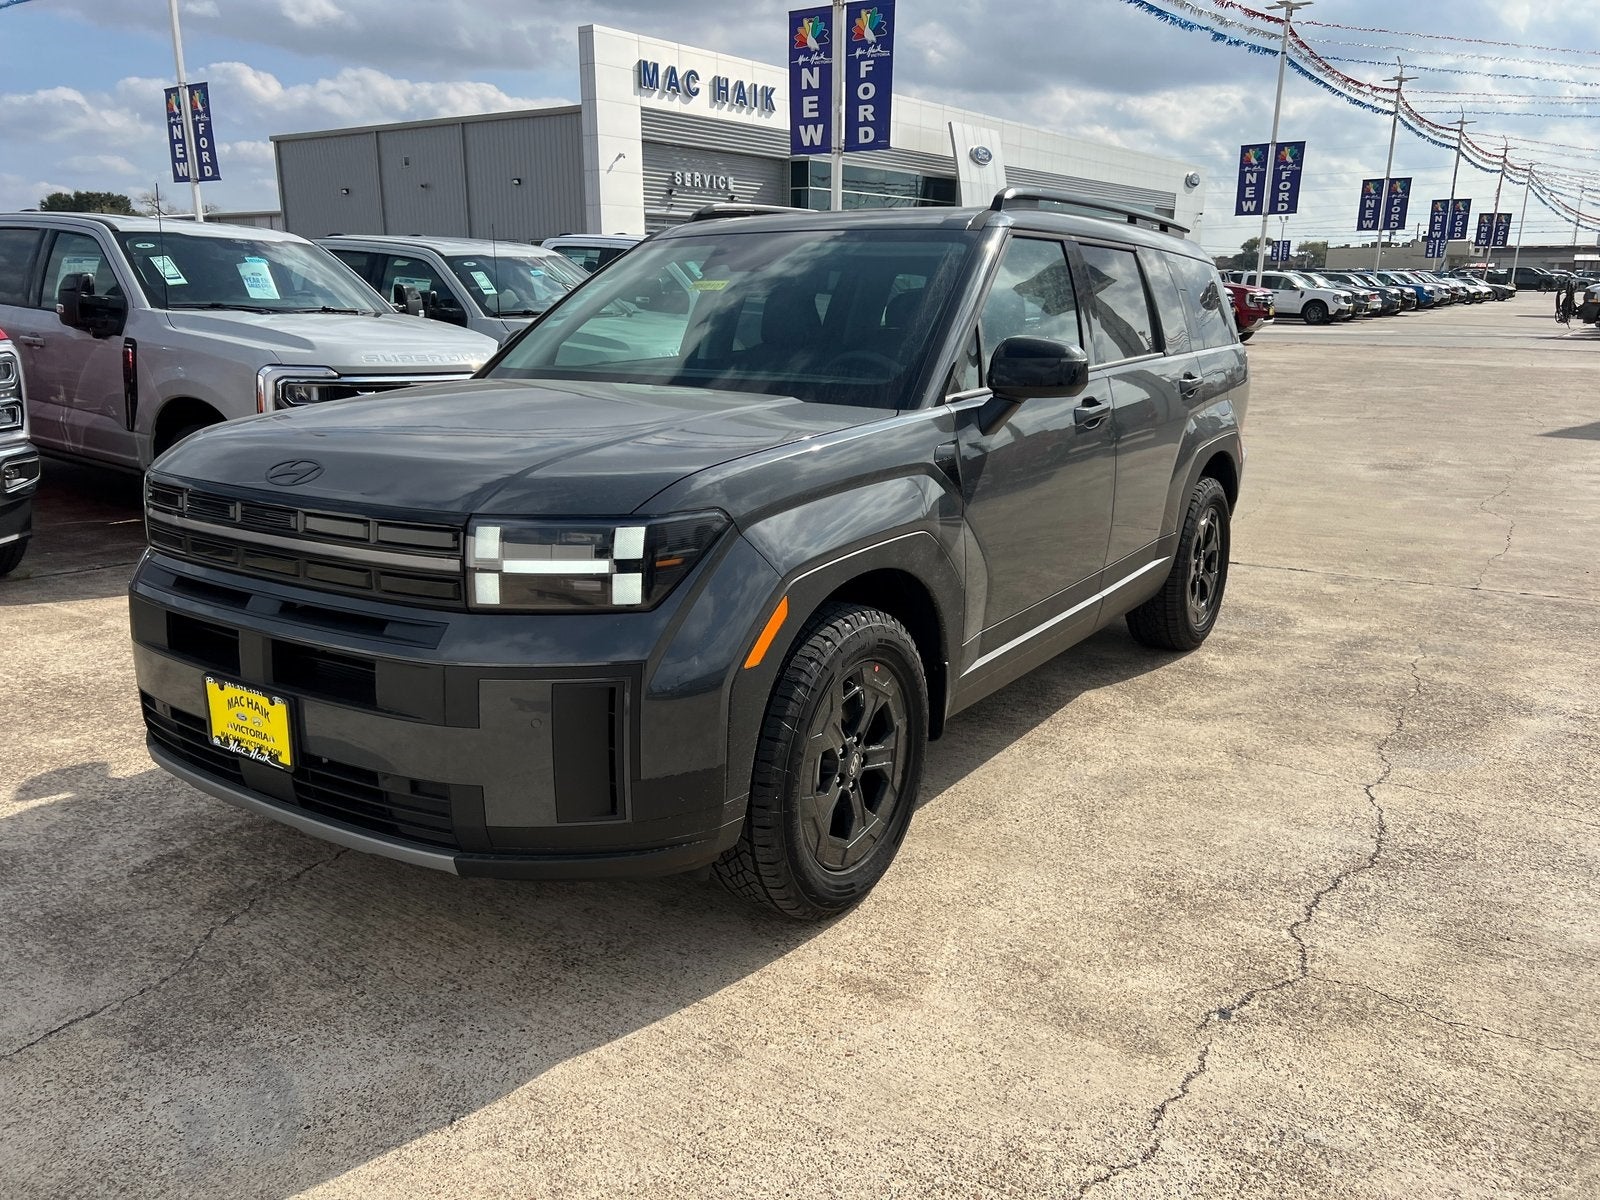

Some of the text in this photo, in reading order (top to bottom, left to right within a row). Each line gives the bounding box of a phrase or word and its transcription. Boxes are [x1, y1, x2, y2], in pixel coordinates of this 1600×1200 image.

[640, 59, 776, 112] MAC HAIK
[799, 67, 824, 146] NEW
[857, 60, 876, 144] FORD
[173, 124, 188, 177] NEW
[198, 123, 213, 177] FORD
[674, 170, 735, 191] SERVICE
[1241, 172, 1258, 212] NEW
[1277, 171, 1292, 212] FORD
[1362, 199, 1376, 229] NEW
[1390, 198, 1403, 229] FORD
[1432, 215, 1442, 238] NEW
[1453, 214, 1464, 238] FORD
[1478, 226, 1488, 245] NEW
[361, 353, 445, 363] SUPER
[227, 696, 271, 723] MAC HAIK
[232, 722, 269, 743] VICTORIA
[227, 740, 276, 765] Mac Haik
